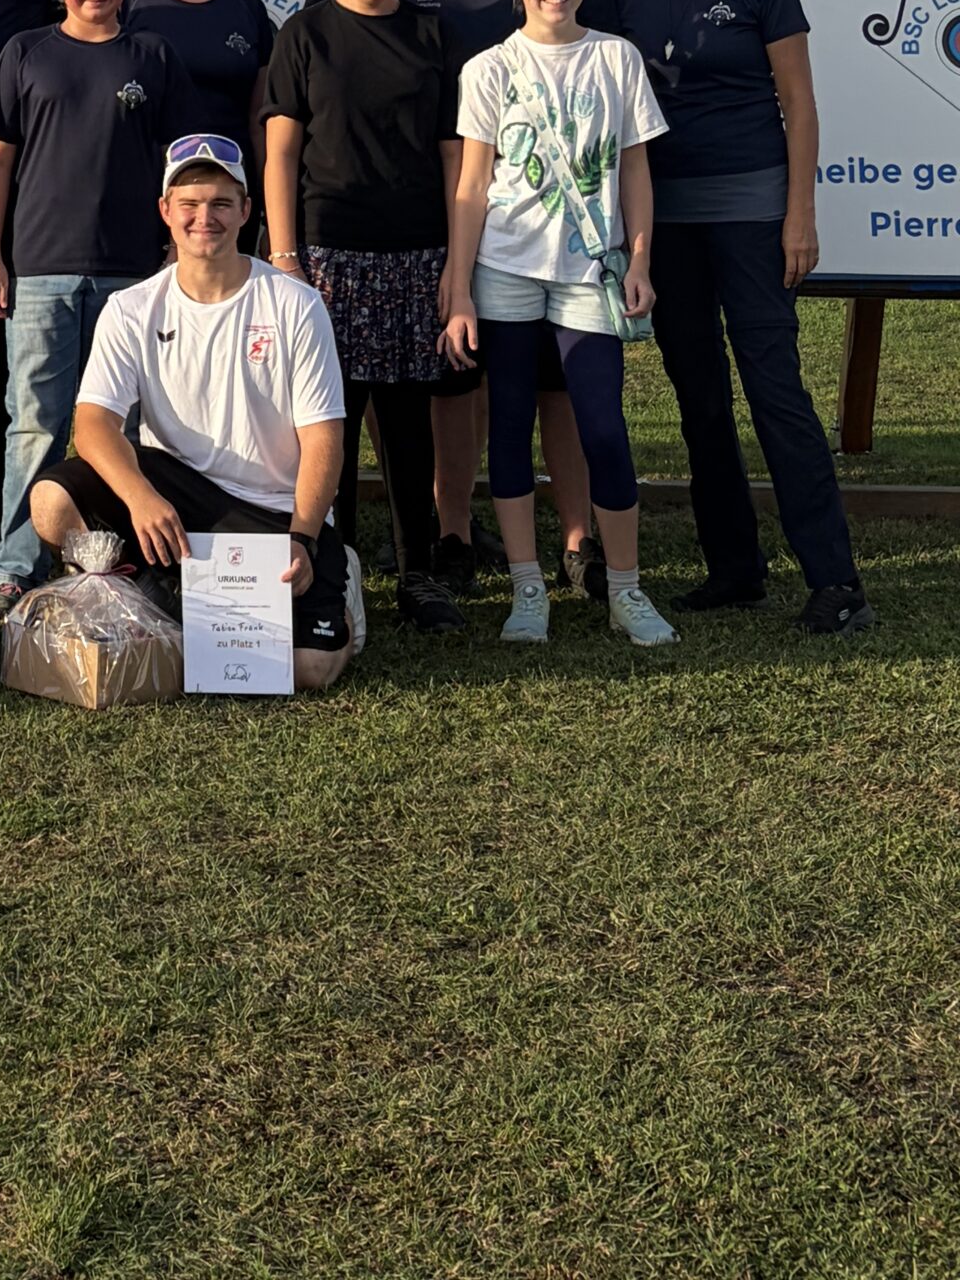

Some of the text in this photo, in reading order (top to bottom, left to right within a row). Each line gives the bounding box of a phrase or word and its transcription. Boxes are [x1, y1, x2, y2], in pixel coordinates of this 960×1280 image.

[901, 6, 930, 55] BSC
[913, 163, 960, 191] ge
[870, 210, 960, 238] Pierr
[218, 575, 257, 583] URKUNDE
[230, 639, 253, 648] Platz
[256, 640, 261, 648] 1
